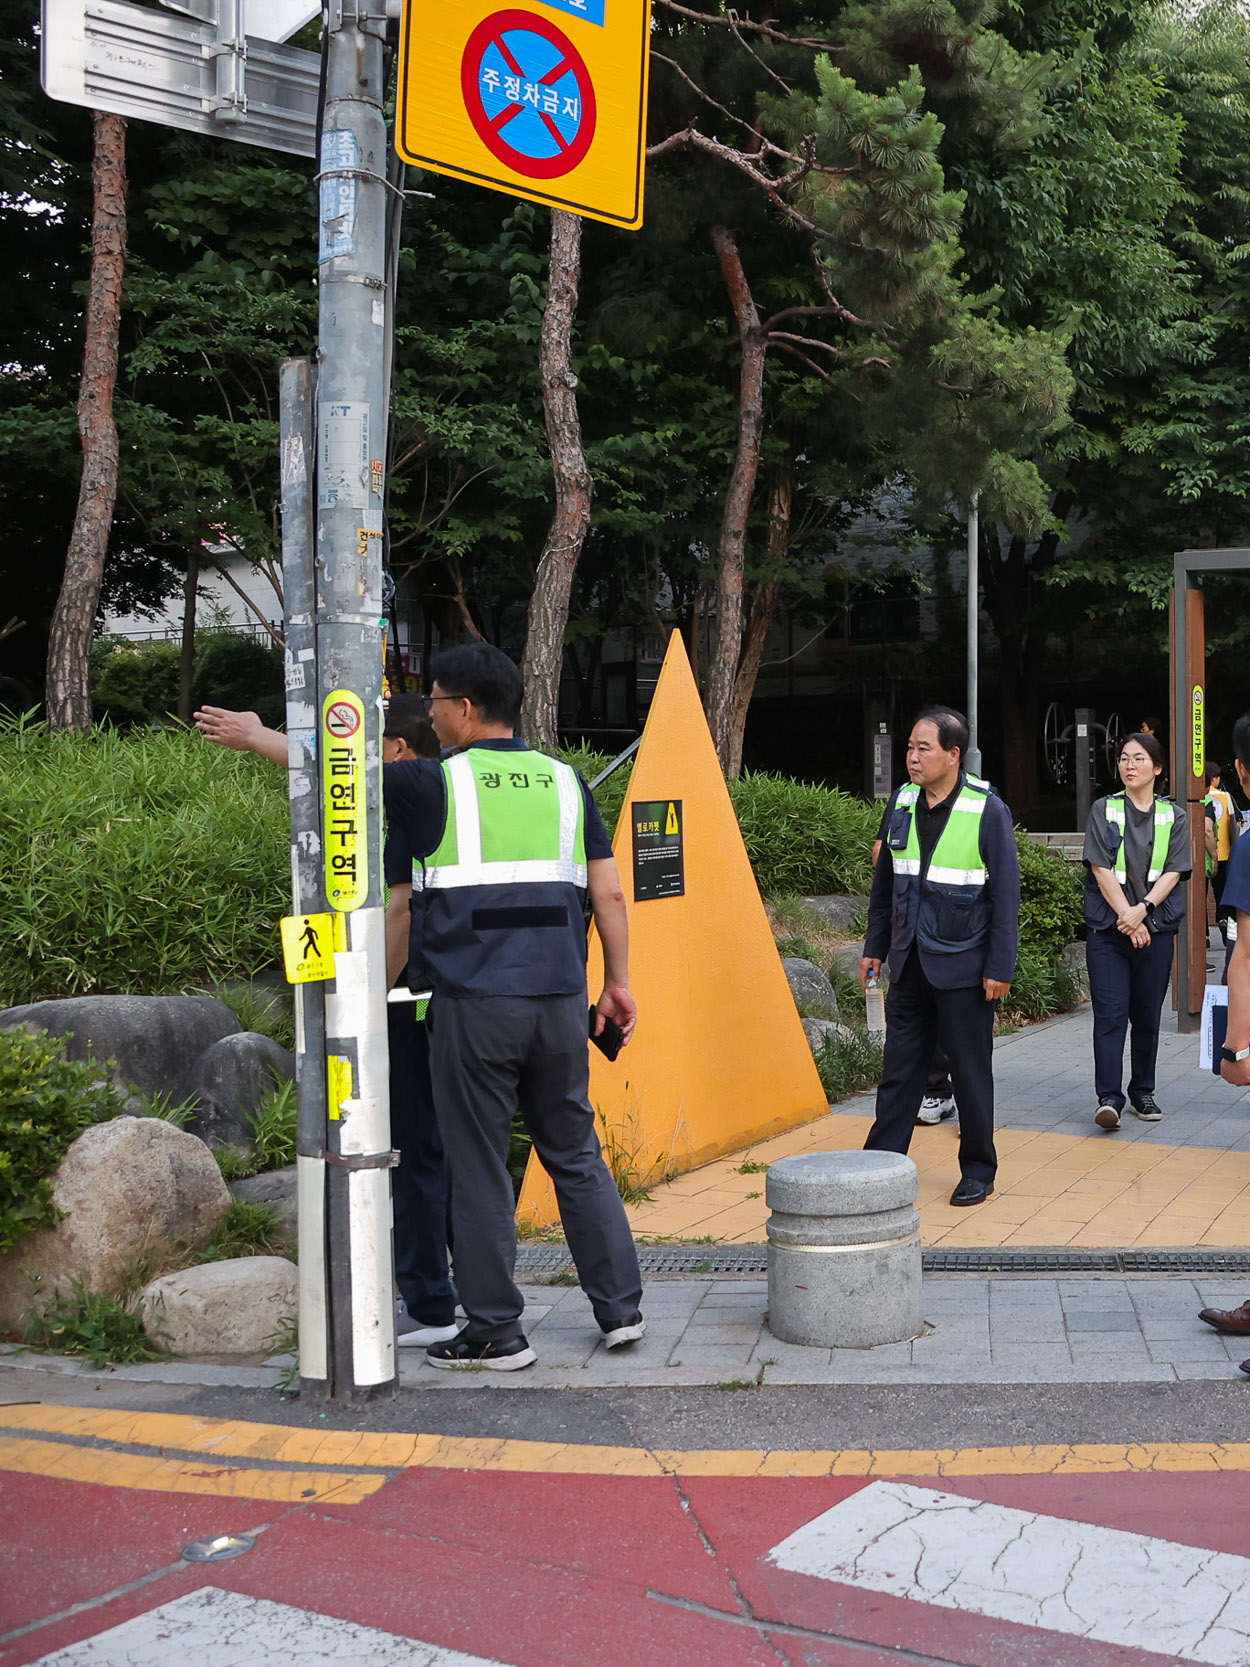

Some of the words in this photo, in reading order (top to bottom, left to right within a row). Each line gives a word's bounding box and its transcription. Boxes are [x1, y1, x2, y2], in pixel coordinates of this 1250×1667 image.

[482, 67, 579, 121] 주정차금지
[1194, 708, 1202, 765] 금연구역
[479, 772, 554, 788] 광진구
[329, 746, 358, 884] 금연구역
